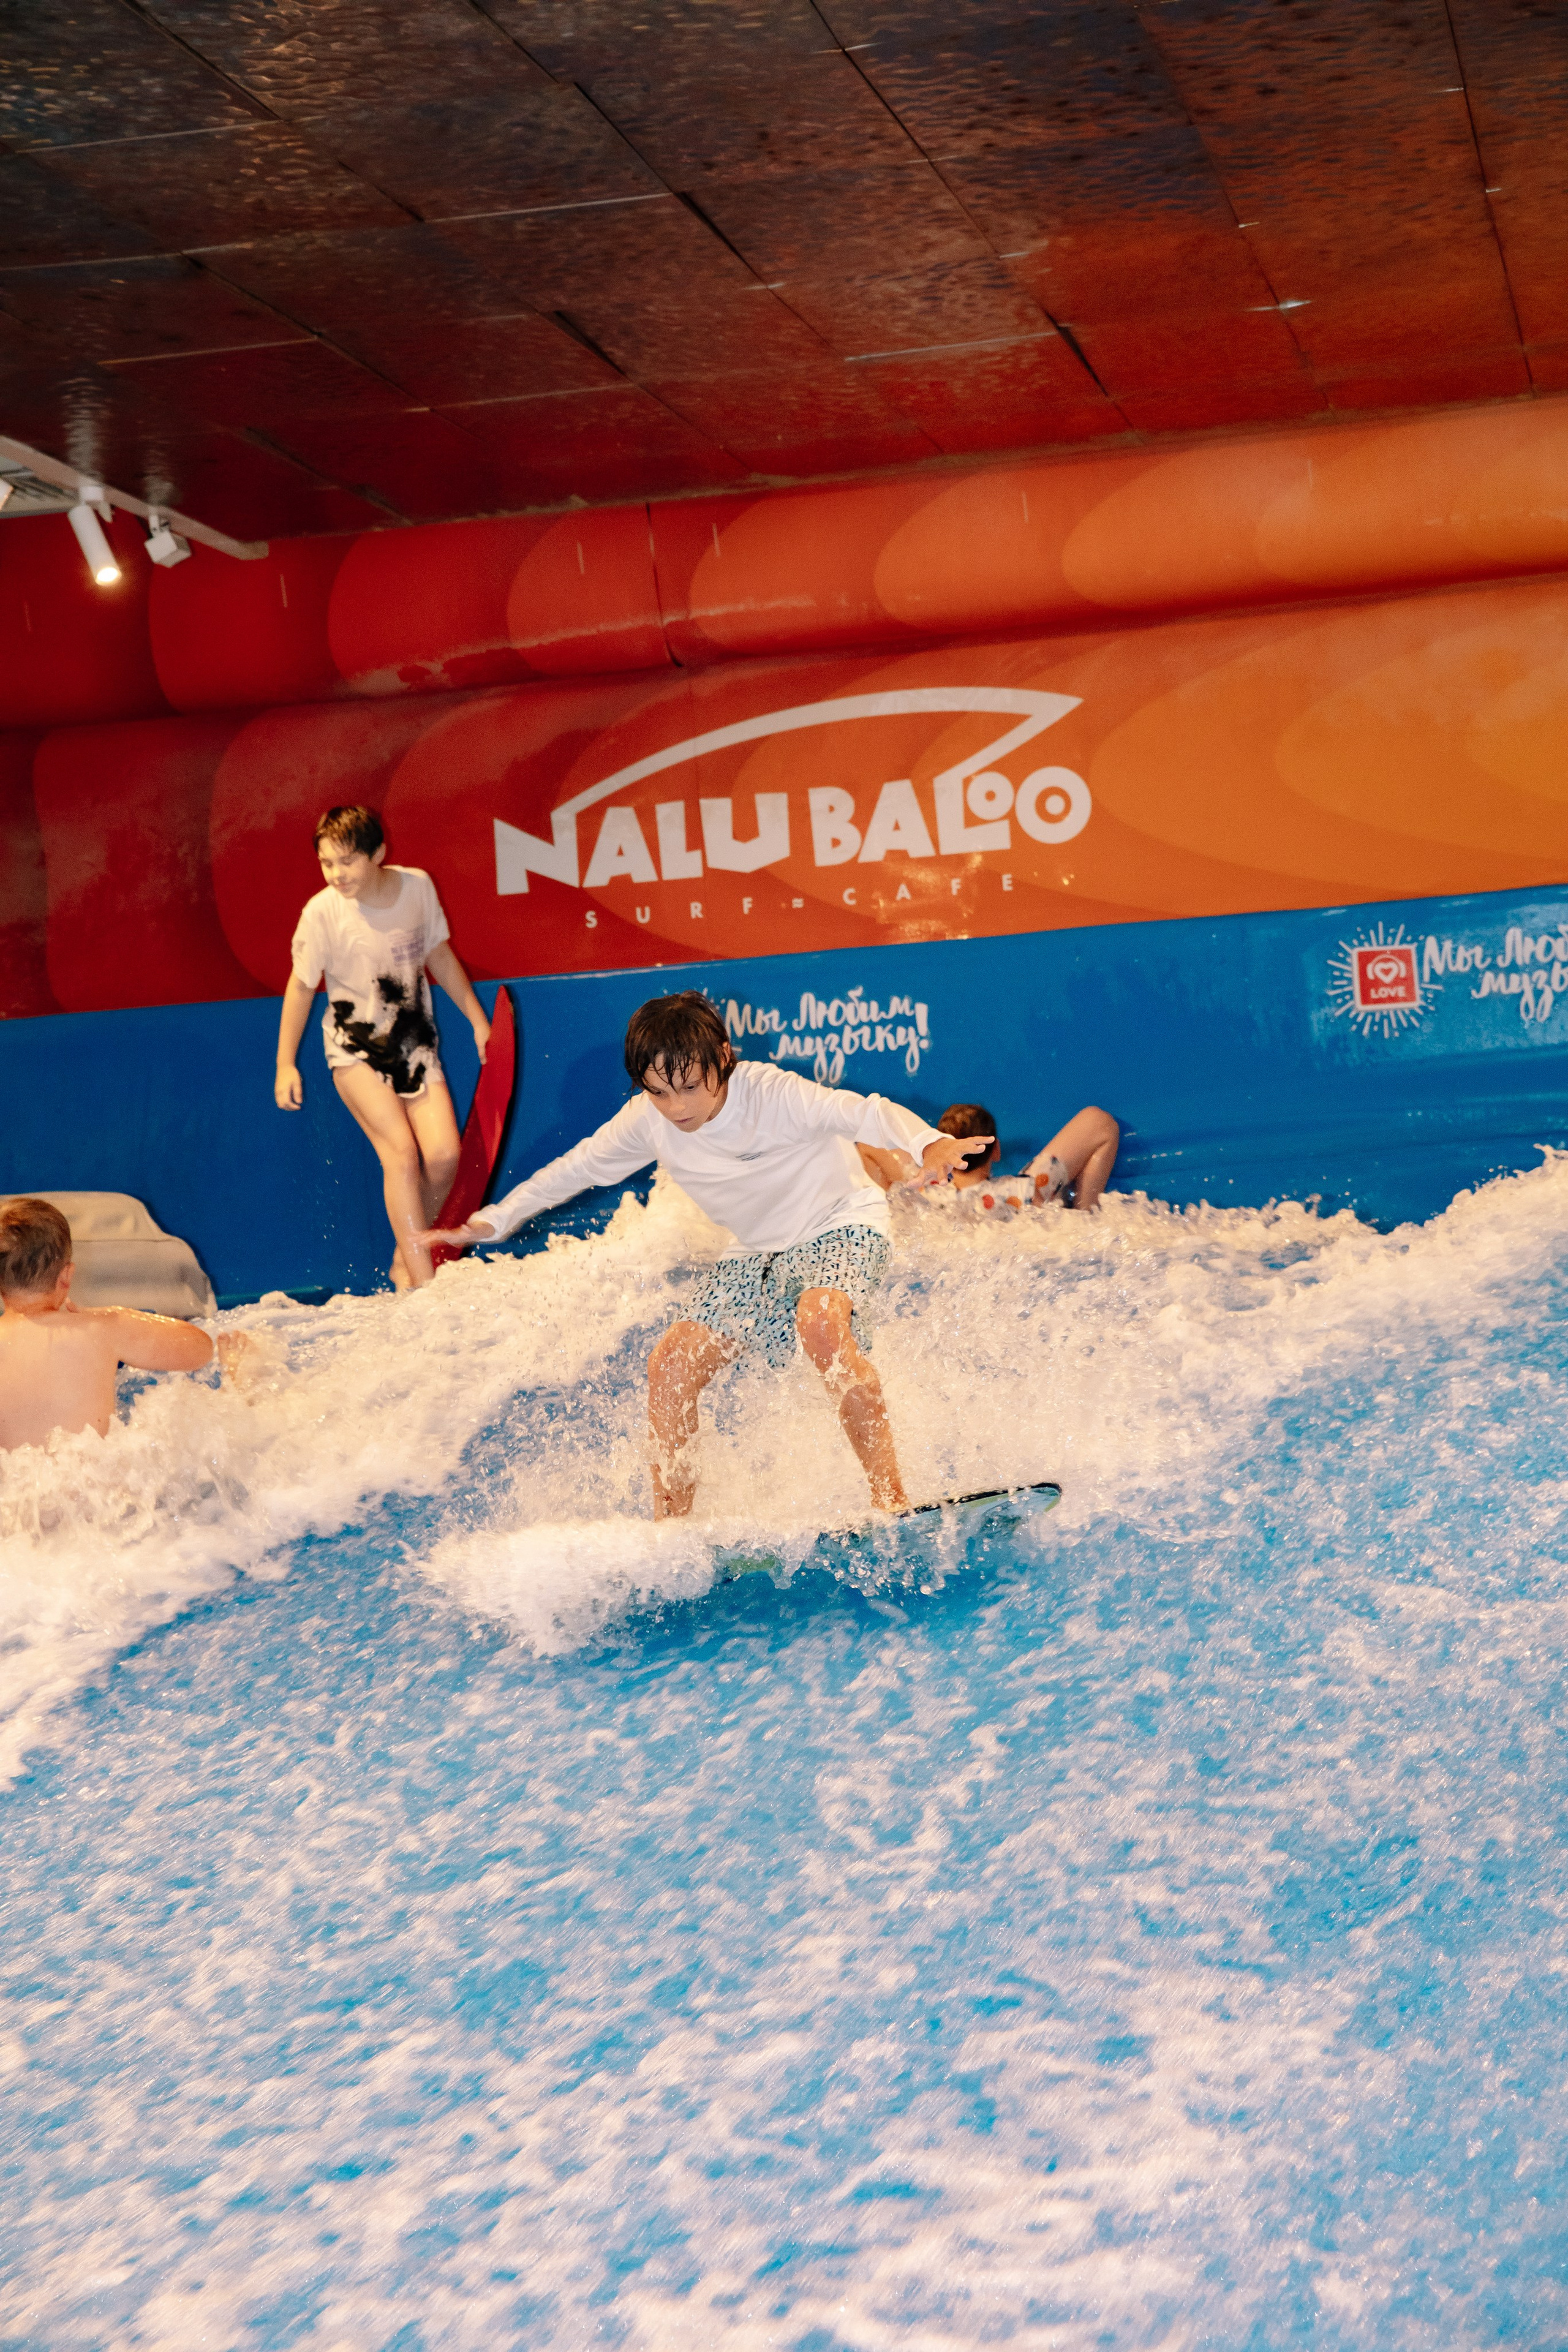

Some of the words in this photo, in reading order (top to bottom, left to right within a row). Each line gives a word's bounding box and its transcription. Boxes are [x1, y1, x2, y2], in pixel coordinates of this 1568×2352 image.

[494, 792, 791, 896] NALU
[808, 766, 1092, 867] BALOO
[585, 897, 753, 929] SURF
[843, 873, 1014, 906] CAFE
[1423, 935, 1492, 982] Мы
[725, 999, 788, 1044] Мы
[793, 986, 915, 1031] Любим
[1370, 986, 1406, 999] LOVE
